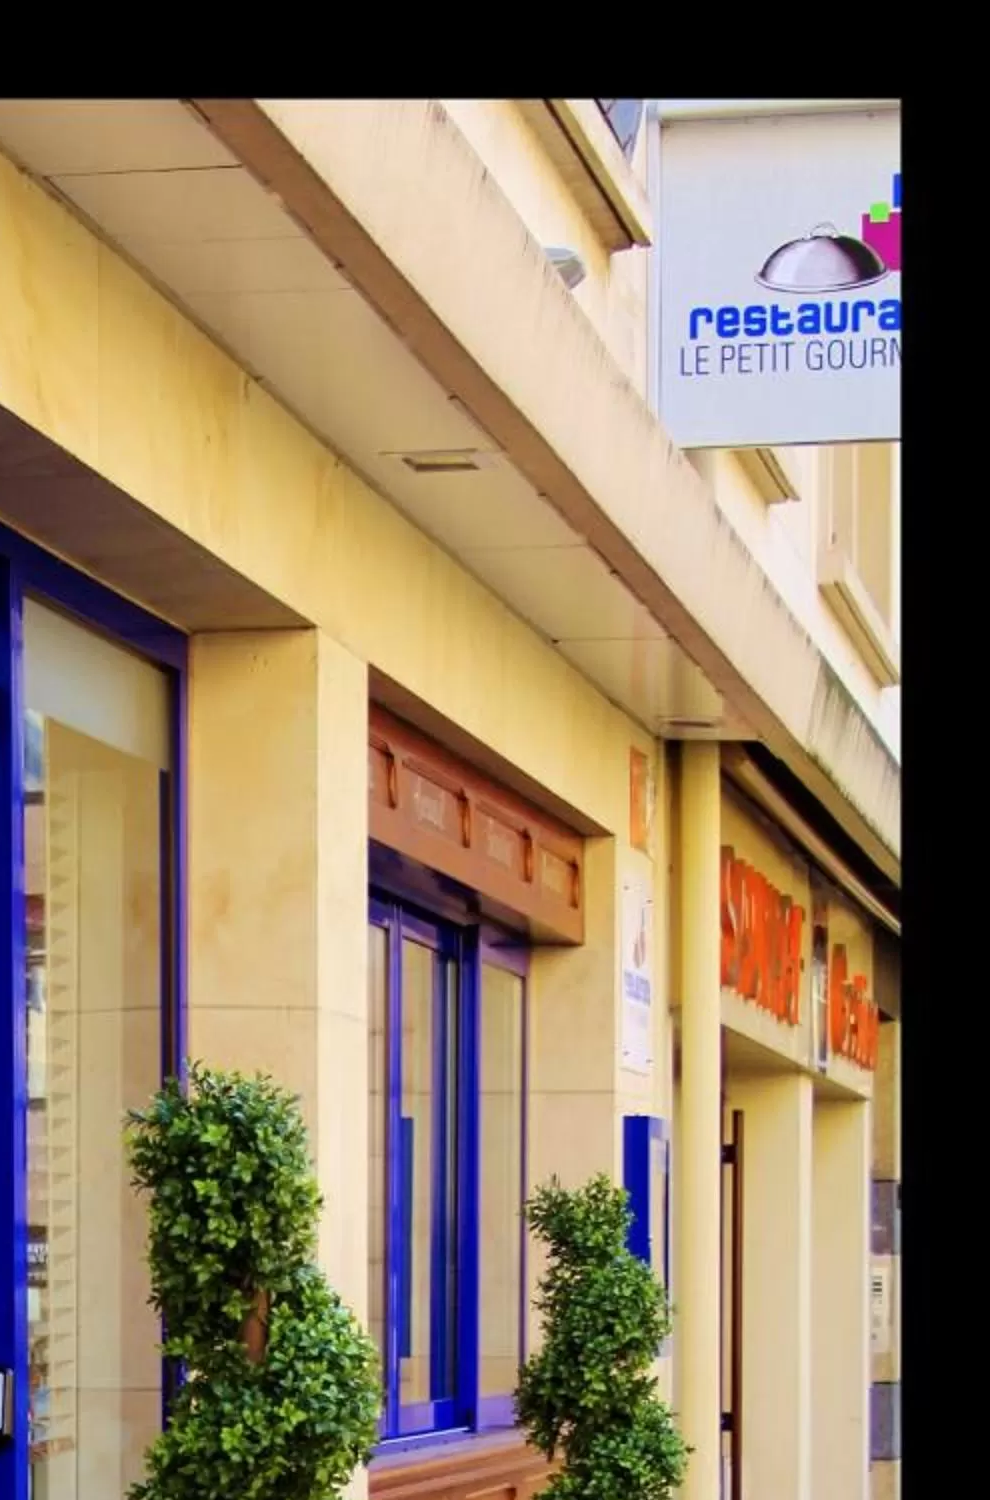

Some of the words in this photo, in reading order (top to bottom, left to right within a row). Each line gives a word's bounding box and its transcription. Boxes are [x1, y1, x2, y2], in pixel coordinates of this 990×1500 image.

[689, 299, 902, 340] restaura
[679, 344, 710, 376] LE
[720, 341, 796, 374] PETIT
